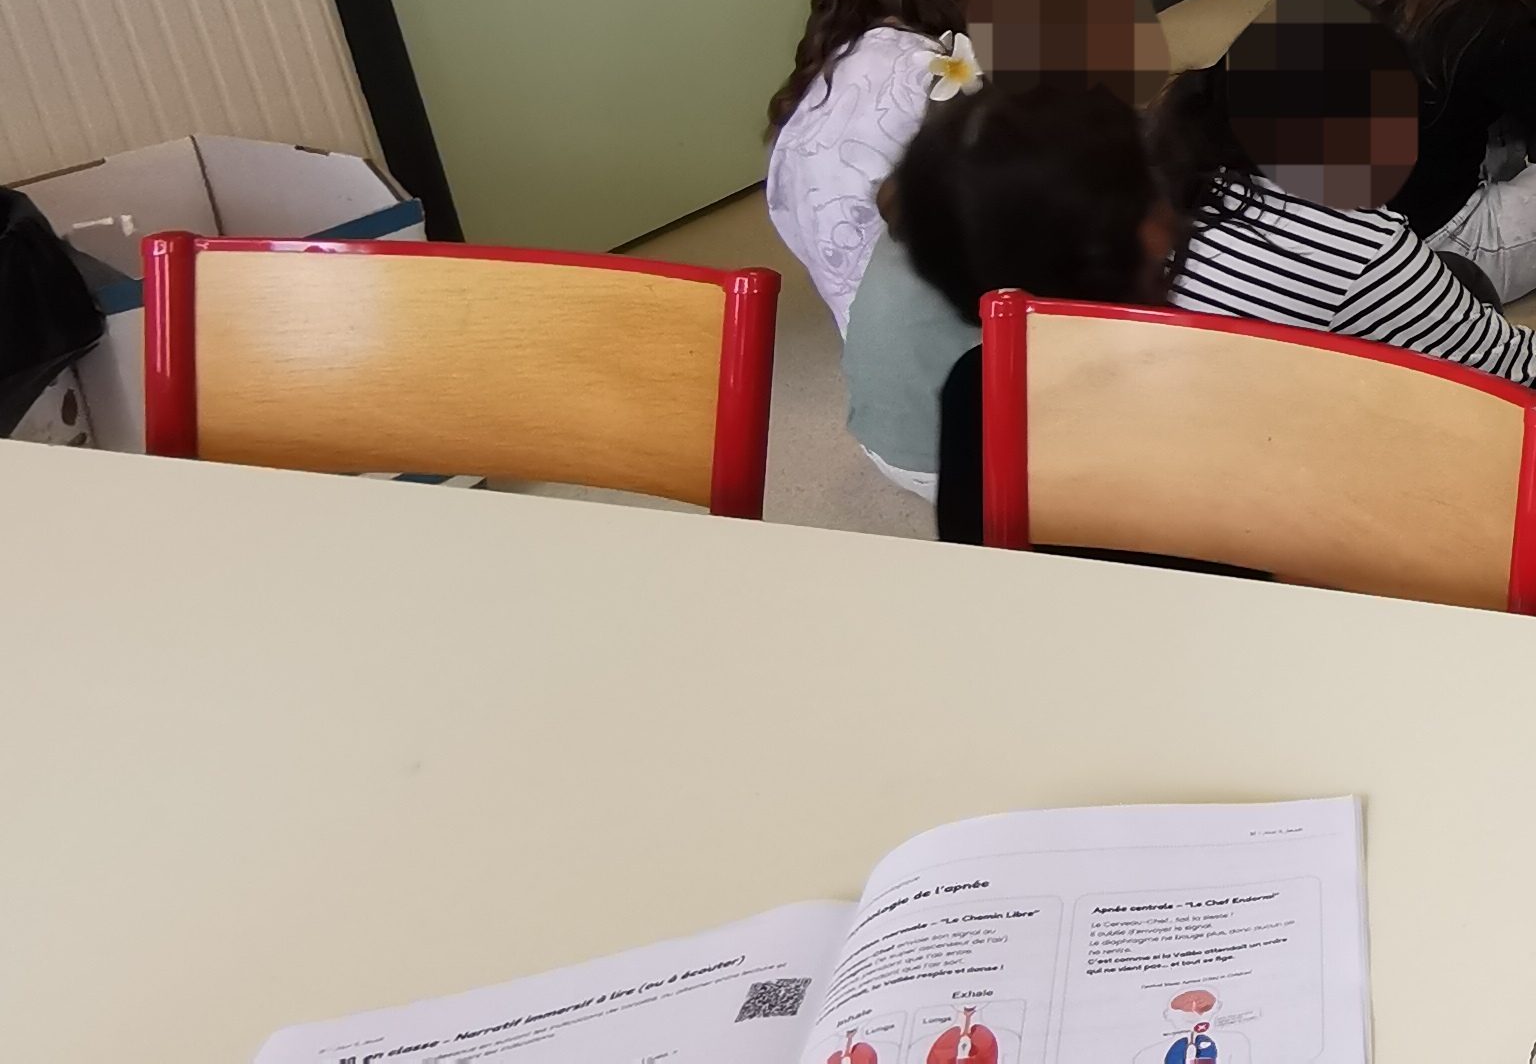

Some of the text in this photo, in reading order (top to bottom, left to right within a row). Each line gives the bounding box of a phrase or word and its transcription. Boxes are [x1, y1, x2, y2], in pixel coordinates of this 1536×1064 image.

[914, 890, 931, 900] de
[962, 912, 1003, 922] Chemin
[952, 989, 993, 999] Exhale
[388, 1040, 439, 1057] classe
[454, 1017, 524, 1041] Narratif
[524, 998, 595, 1024] immersif
[610, 986, 636, 1001] lire
